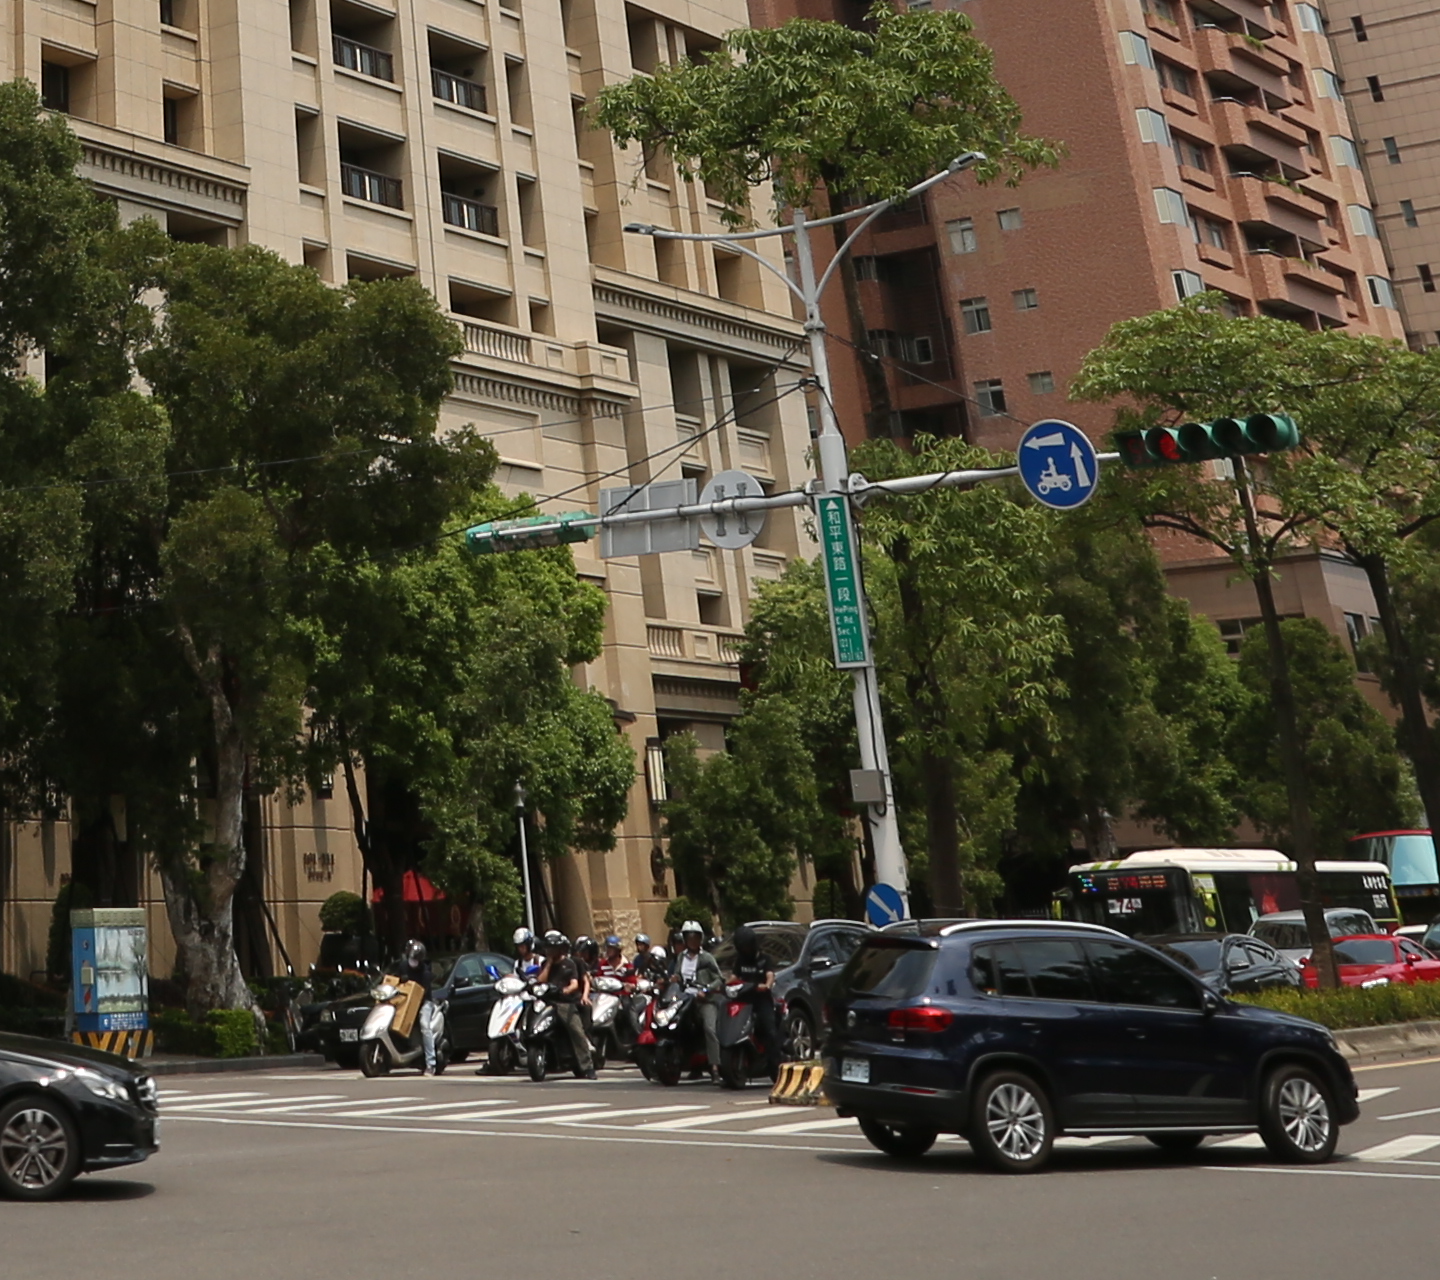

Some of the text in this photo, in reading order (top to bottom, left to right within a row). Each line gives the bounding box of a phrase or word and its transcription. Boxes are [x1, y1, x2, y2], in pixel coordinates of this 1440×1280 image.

[827, 511, 852, 602] 和平東路一段
